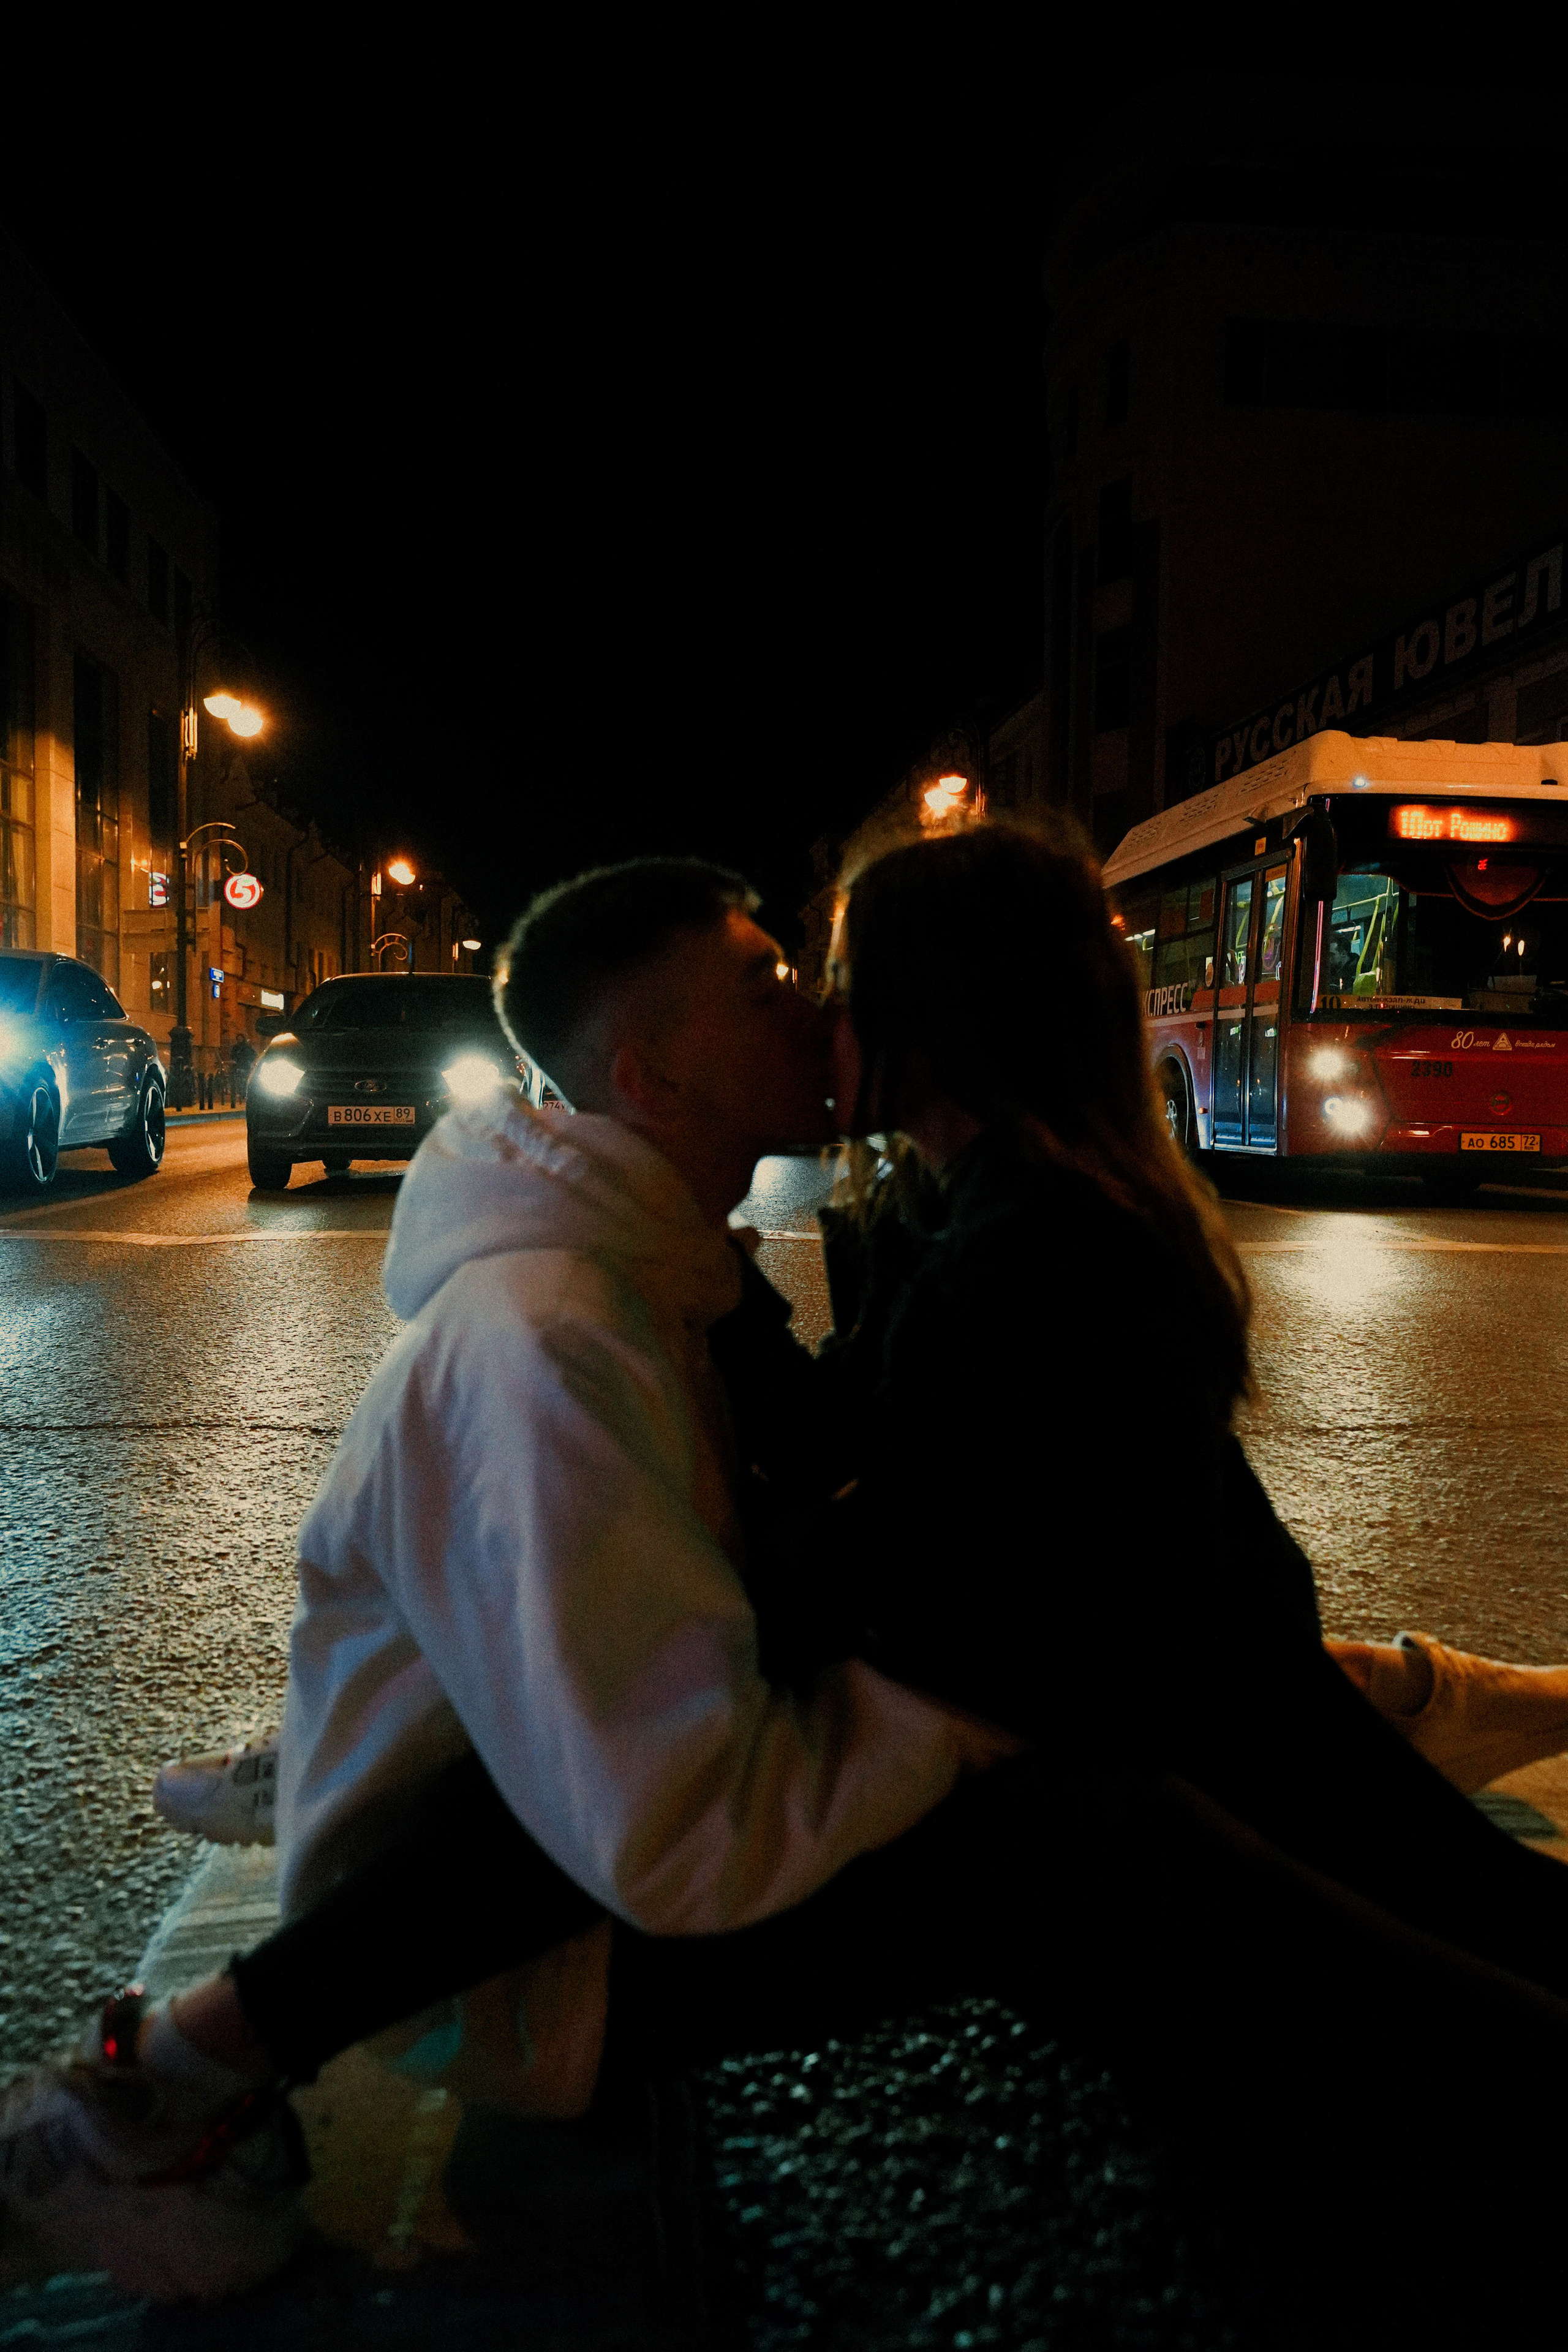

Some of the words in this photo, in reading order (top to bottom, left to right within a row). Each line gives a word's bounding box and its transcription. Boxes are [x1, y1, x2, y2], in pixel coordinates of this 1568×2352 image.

[1215, 654, 1374, 782] РУССКАЯ
[1394, 542, 1564, 690] ЮВЕЛ
[1321, 996, 1341, 1009] 10
[1451, 1031, 1474, 1049] 80
[396, 1108, 410, 1118] 89
[1523, 1136, 1536, 1146] 72
